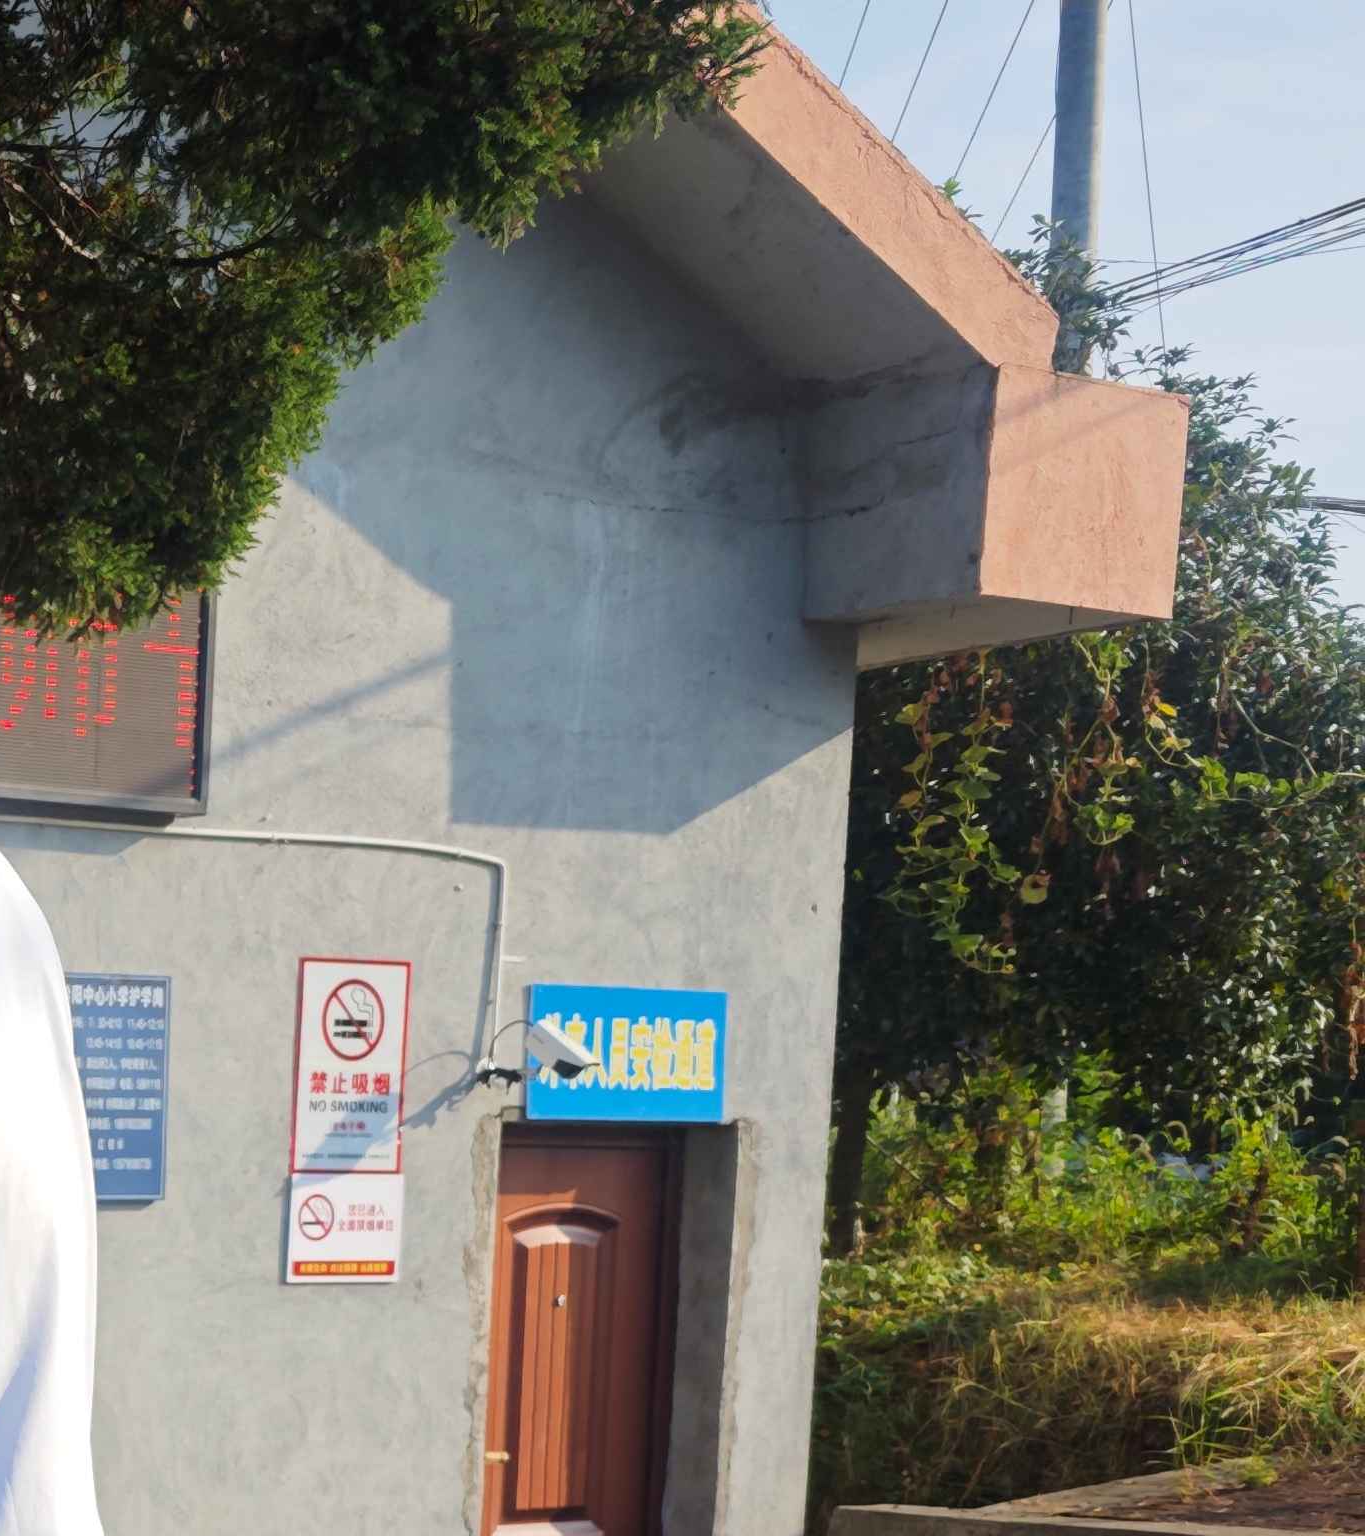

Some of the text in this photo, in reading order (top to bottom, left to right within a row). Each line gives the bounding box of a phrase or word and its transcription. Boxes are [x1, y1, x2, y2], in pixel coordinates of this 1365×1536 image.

[310, 1071, 391, 1095] 禁止吸烟
[309, 1100, 388, 1114] NO SMOKING
